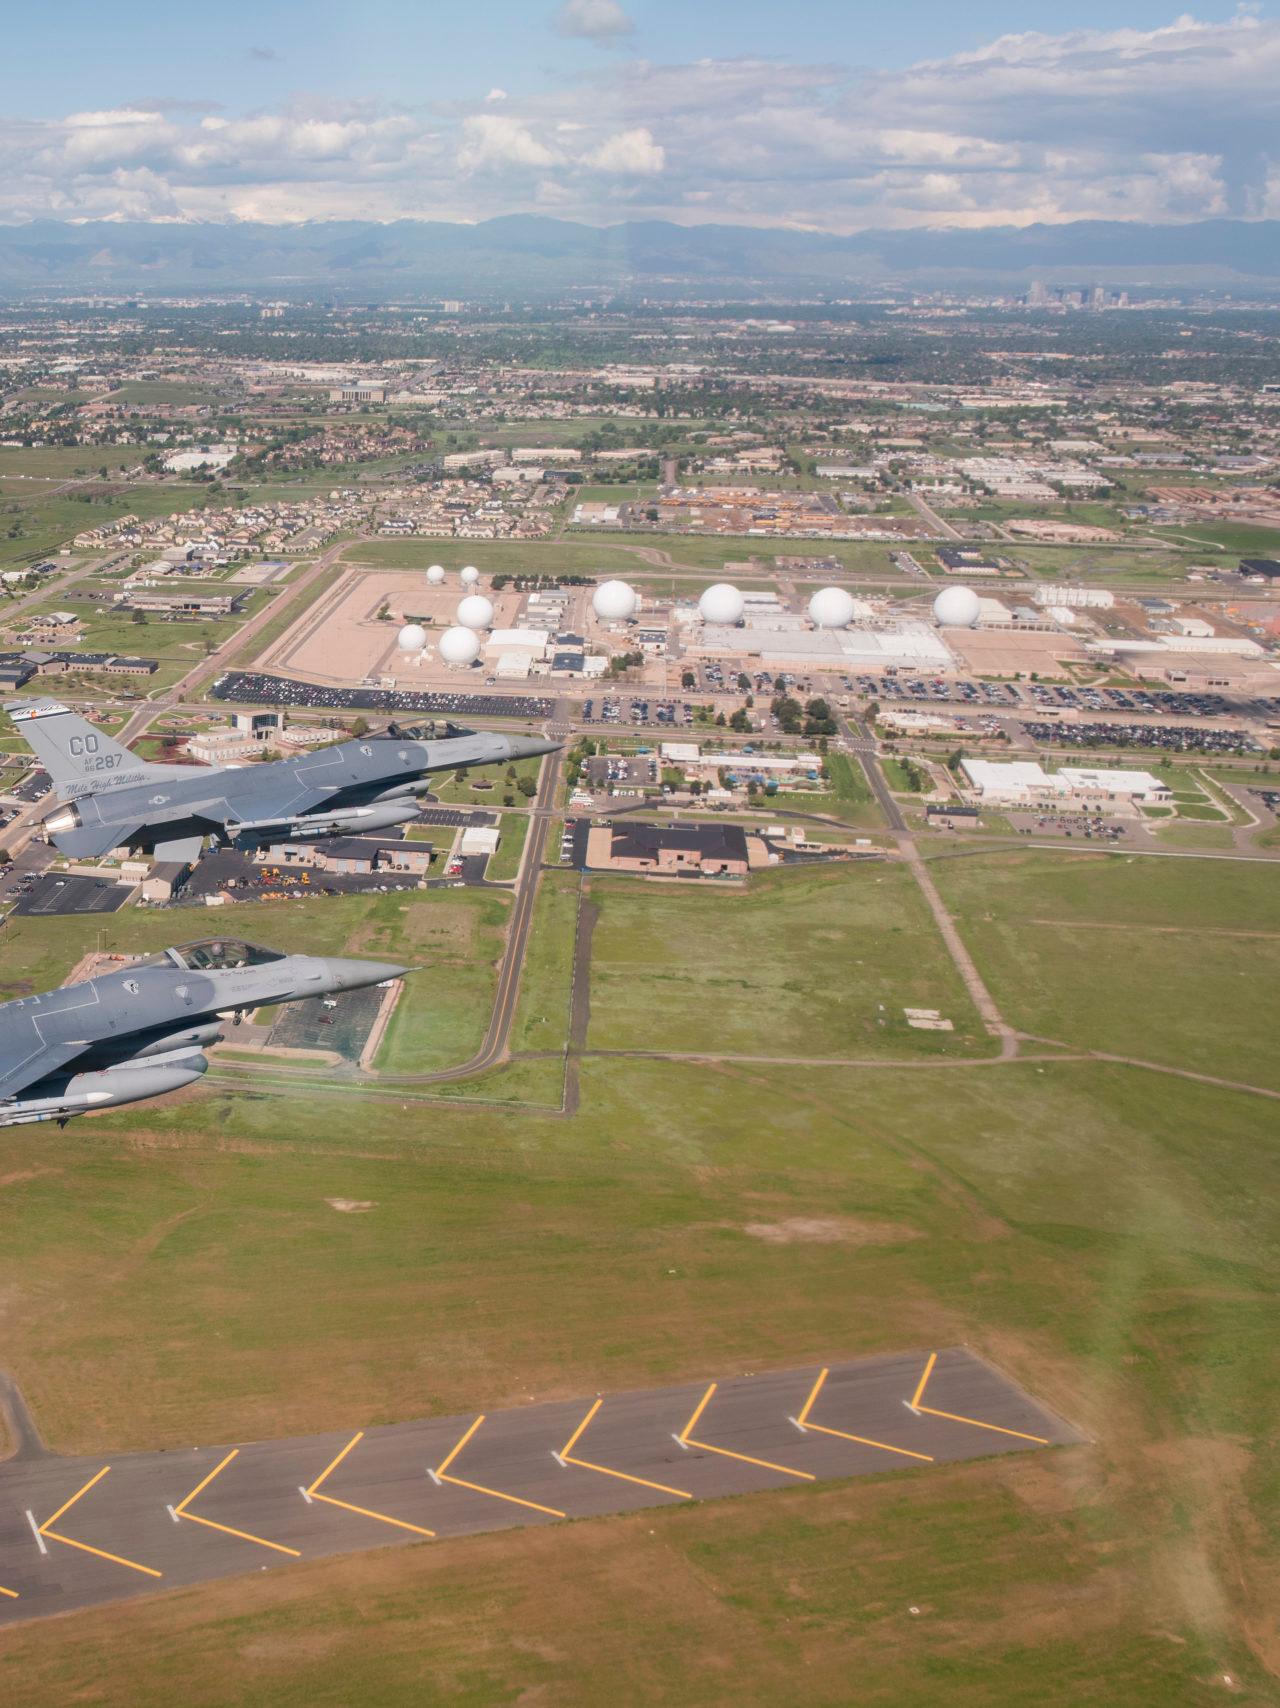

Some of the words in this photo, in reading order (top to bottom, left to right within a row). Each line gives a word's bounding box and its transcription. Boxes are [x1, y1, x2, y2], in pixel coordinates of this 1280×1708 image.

[69, 734, 99, 756] CO
[95, 753, 123, 770] 287
[65, 784, 88, 794] Mile
[90, 779, 112, 792] High
